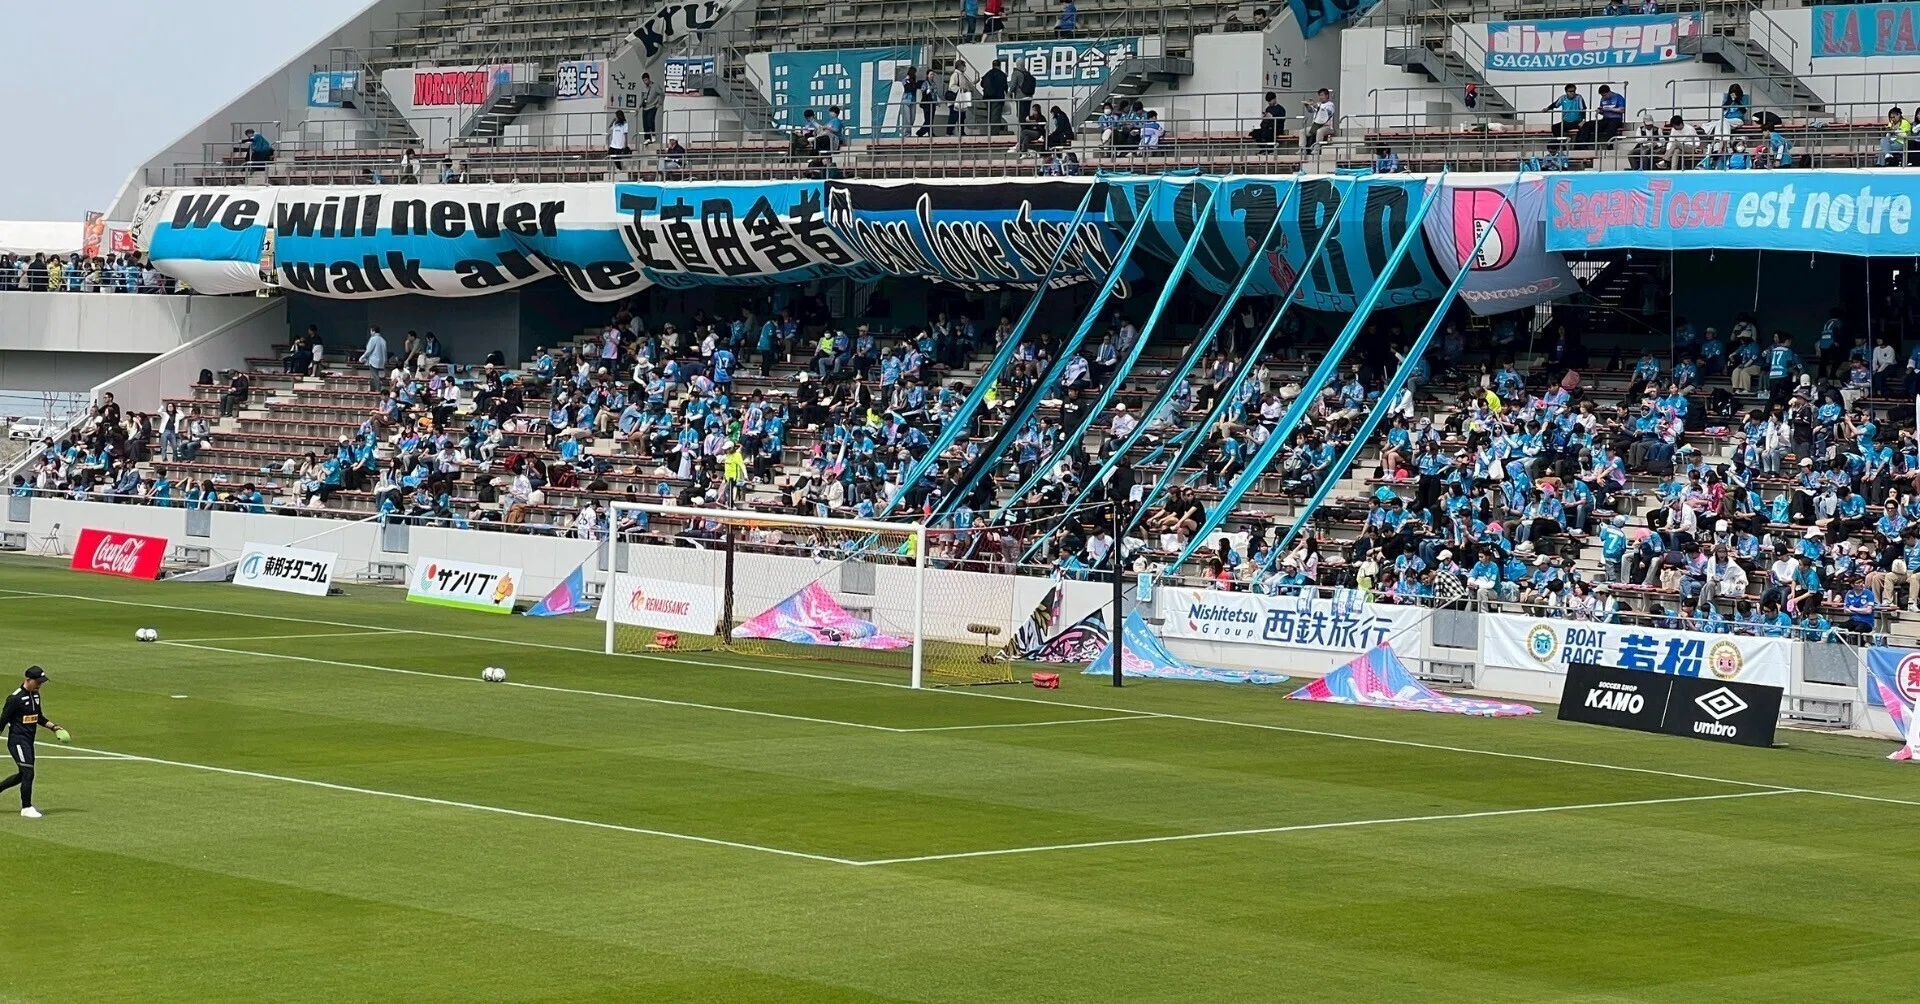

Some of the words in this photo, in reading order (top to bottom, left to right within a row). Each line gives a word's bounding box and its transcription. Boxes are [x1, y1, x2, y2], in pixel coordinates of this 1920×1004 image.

[1823, 9, 1861, 53] LA
[1283, 58, 1292, 67] 2F
[1493, 52, 1608, 68] SAGANTOSU
[1613, 50, 1638, 63] 17
[413, 71, 488, 106] NORIYOSHI
[557, 66, 599, 96] 雄大
[628, 82, 636, 91] 2F
[172, 194, 260, 230] We
[277, 194, 381, 238] will
[391, 199, 565, 238] never
[1736, 184, 1795, 229] est
[1801, 184, 1912, 235] notre
[828, 186, 941, 275] Tosu
[916, 192, 1019, 280] love
[282, 251, 435, 294] walk
[718, 356, 729, 369] 17
[1772, 351, 1783, 365] 17
[961, 512, 970, 523] 19
[1608, 534, 1618, 550] 7
[263, 556, 328, 583] 東邦チタニウム
[437, 568, 497, 596] サンリブ
[644, 597, 690, 615] RENAISSANCE
[1188, 603, 1258, 624] Nishitetsu
[1202, 624, 1254, 638] Group
[1263, 609, 1393, 648] 西鉄旅行
[1565, 628, 1606, 648] BOAT
[1561, 647, 1603, 665] RACE
[1617, 634, 1705, 677] 若松
[1598, 681, 1621, 691] SOCCER
[1621, 684, 1638, 692] SHOP
[1584, 688, 1645, 714] KAMO
[1694, 720, 1737, 738] umbro
